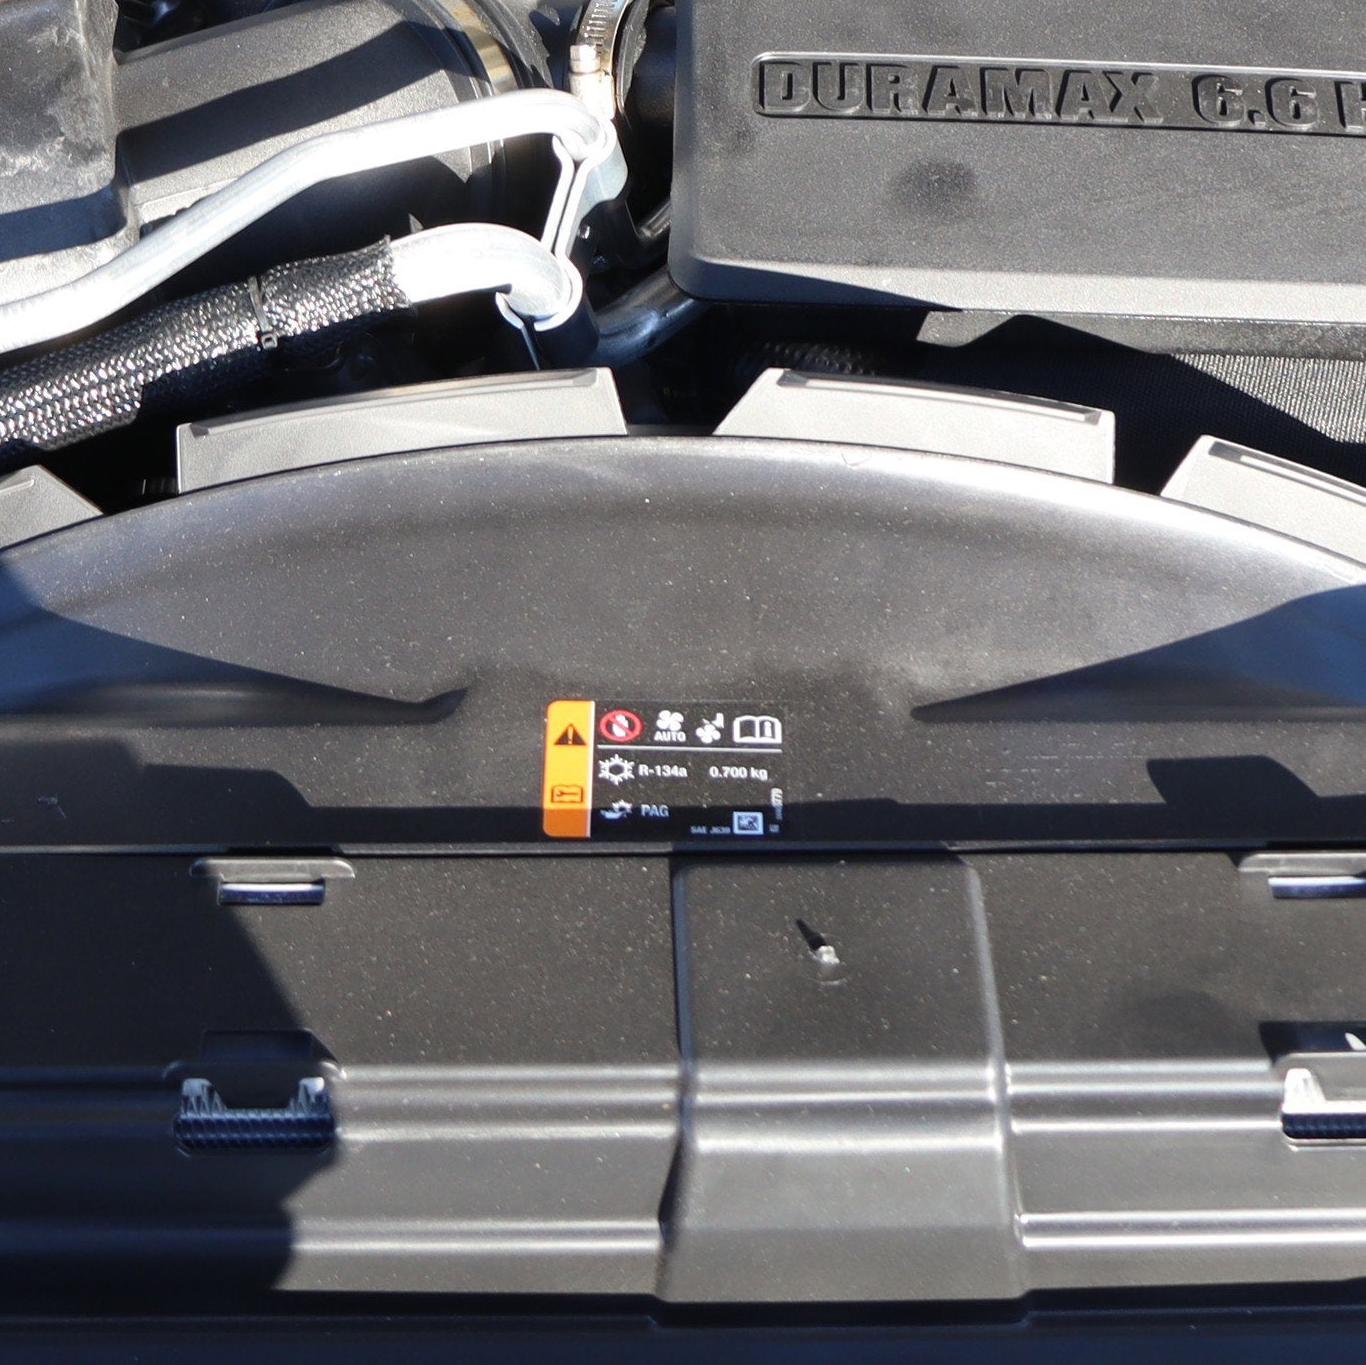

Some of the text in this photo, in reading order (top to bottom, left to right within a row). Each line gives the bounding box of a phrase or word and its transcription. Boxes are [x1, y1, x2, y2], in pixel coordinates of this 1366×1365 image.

[758, 60, 1164, 124] DURAMAX
[1192, 73, 1320, 130] 6.6
[653, 731, 686, 742] AUTO
[638, 764, 768, 781] R-134a 0.700 kg
[640, 803, 670, 818] PAG
